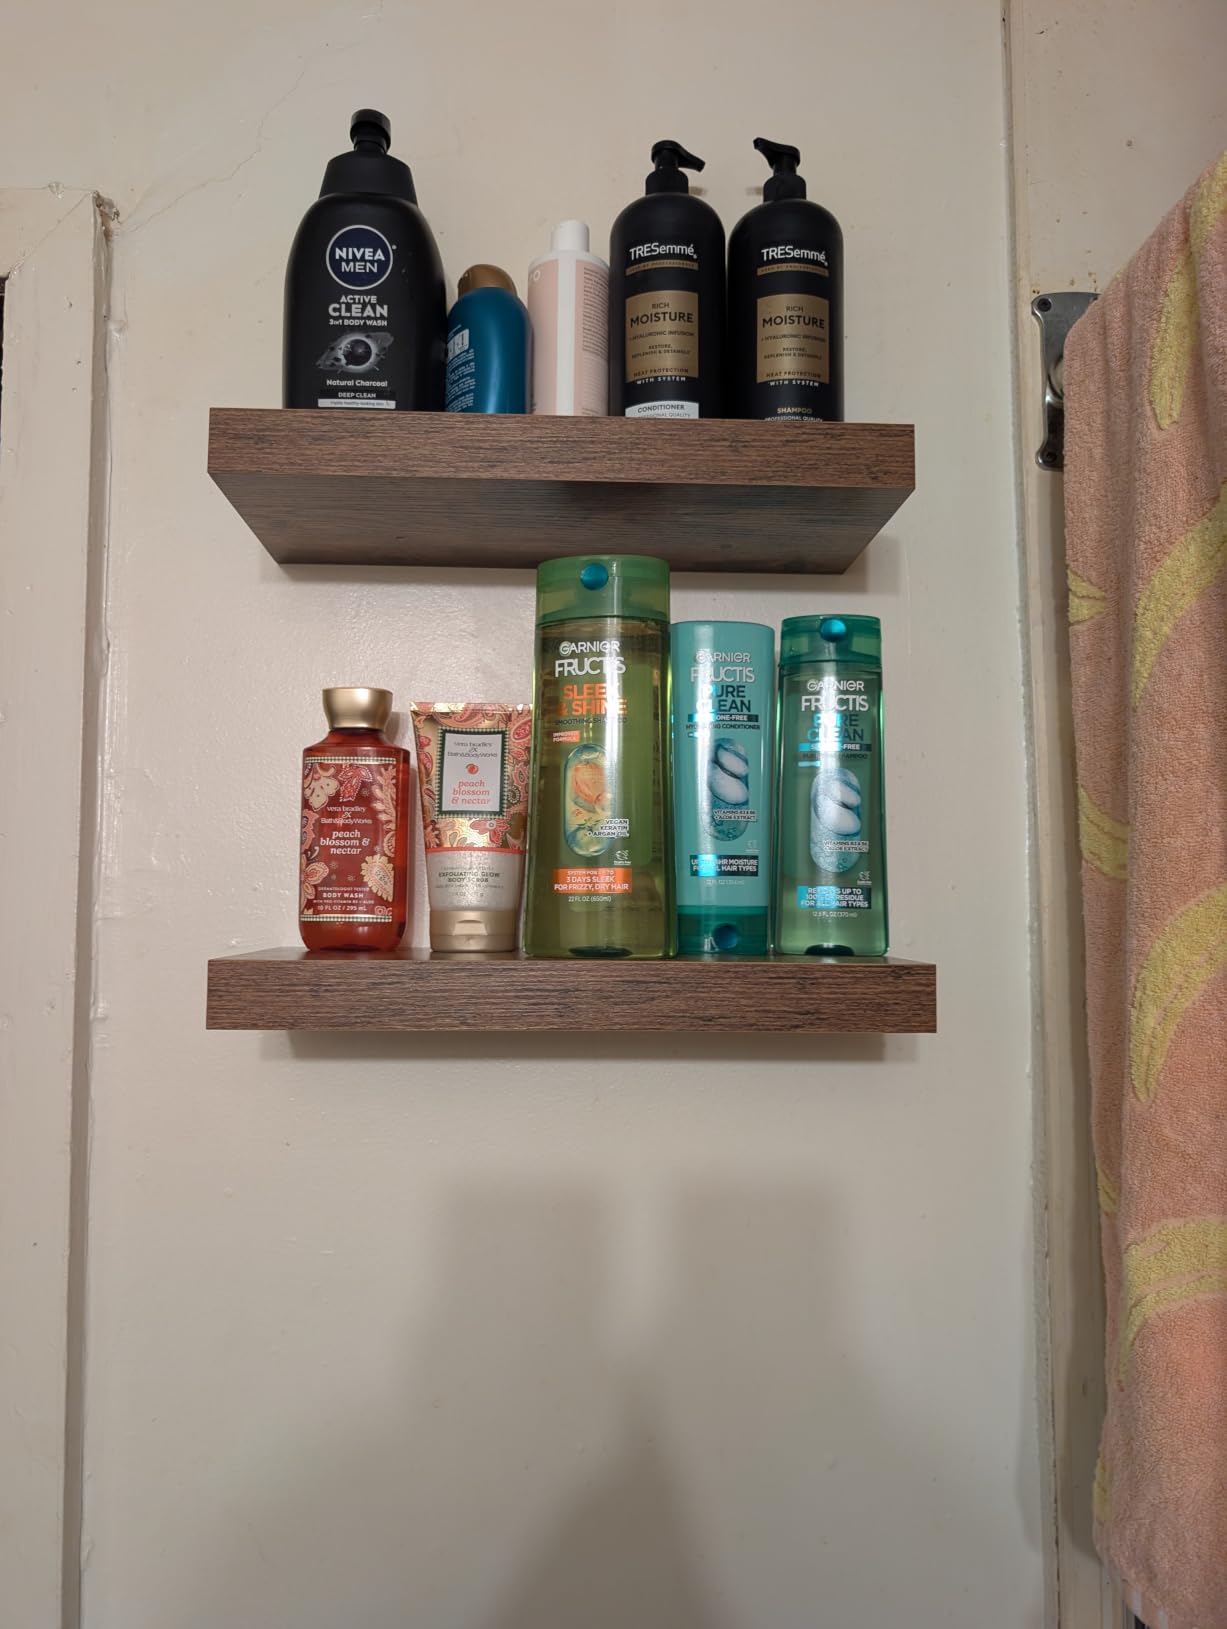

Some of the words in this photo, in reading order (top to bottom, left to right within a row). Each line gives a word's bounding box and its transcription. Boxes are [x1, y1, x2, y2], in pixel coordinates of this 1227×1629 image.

[335, 247, 385, 260] NIVEA
[629, 242, 695, 260] TRESemmé
[760, 246, 826, 264] TRESemmé
[341, 262, 378, 272] MEN
[340, 295, 378, 303] ACTIVE
[328, 303, 388, 318] CLEAN
[630, 312, 695, 328] MOISTURE
[762, 315, 825, 330] MOISTURE
[637, 404, 685, 413] CONDITIONER
[559, 640, 620, 656] GARNIER
[696, 650, 751, 664] GARNIER
[458, 780, 486, 788] peach
[452, 788, 490, 796] blossom
[451, 796, 460, 804] &
[462, 796, 491, 805] nectar
[332, 829, 360, 839] peach
[320, 838, 360, 846] blossom
[362, 838, 370, 846] &
[568, 884, 594, 892] FRIZZY,
